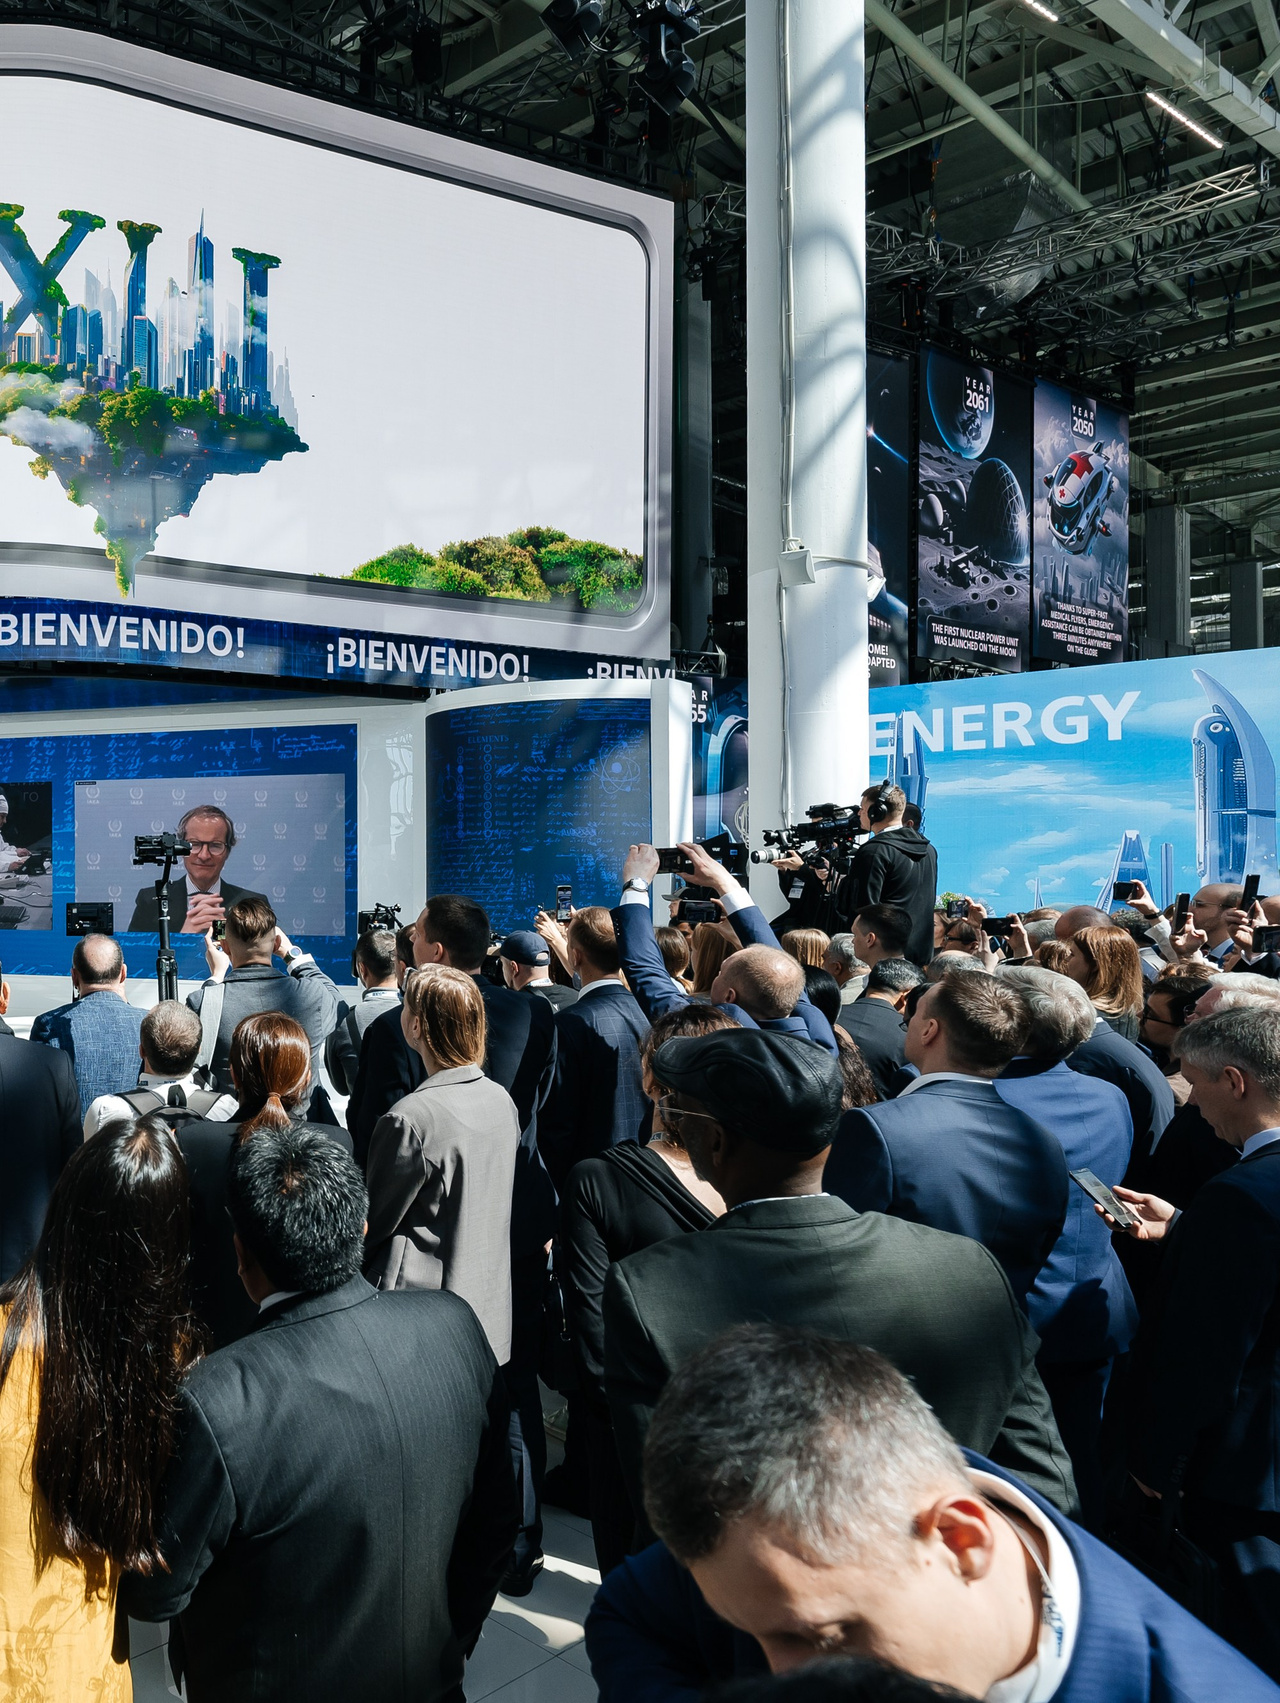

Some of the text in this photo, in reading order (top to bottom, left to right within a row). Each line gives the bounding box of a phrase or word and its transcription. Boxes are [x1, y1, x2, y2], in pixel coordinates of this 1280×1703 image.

[966, 376, 990, 394] YEAR
[966, 390, 988, 413] 2061
[1072, 405, 1094, 420] YEAR
[1073, 416, 1094, 437] 2050
[1051, 610, 1070, 622] MEDICAL
[1088, 619, 1114, 630] EMERGENCY
[1057, 602, 1075, 612] THANKS
[1082, 607, 1108, 620] SUPER-FAST
[932, 623, 1019, 647] THE FIRST NUCLEAR POWER UNIT
[1041, 619, 1068, 631] ASSISTANCE
[1068, 624, 1078, 633] CAN
[1085, 628, 1106, 639] OBTAINED
[1107, 632, 1122, 642] WITHIN
[1053, 631, 1112, 650] THREE MINUTES ANYWHERE
[934, 635, 1016, 657] WAS LAUNCHED ON THE MOON
[1075, 646, 1083, 654] THE
[1084, 648, 1098, 657] GLOBE
[326, 636, 530, 682] ¡BIENVENIDO!
[869, 690, 1141, 757] ENERGY
